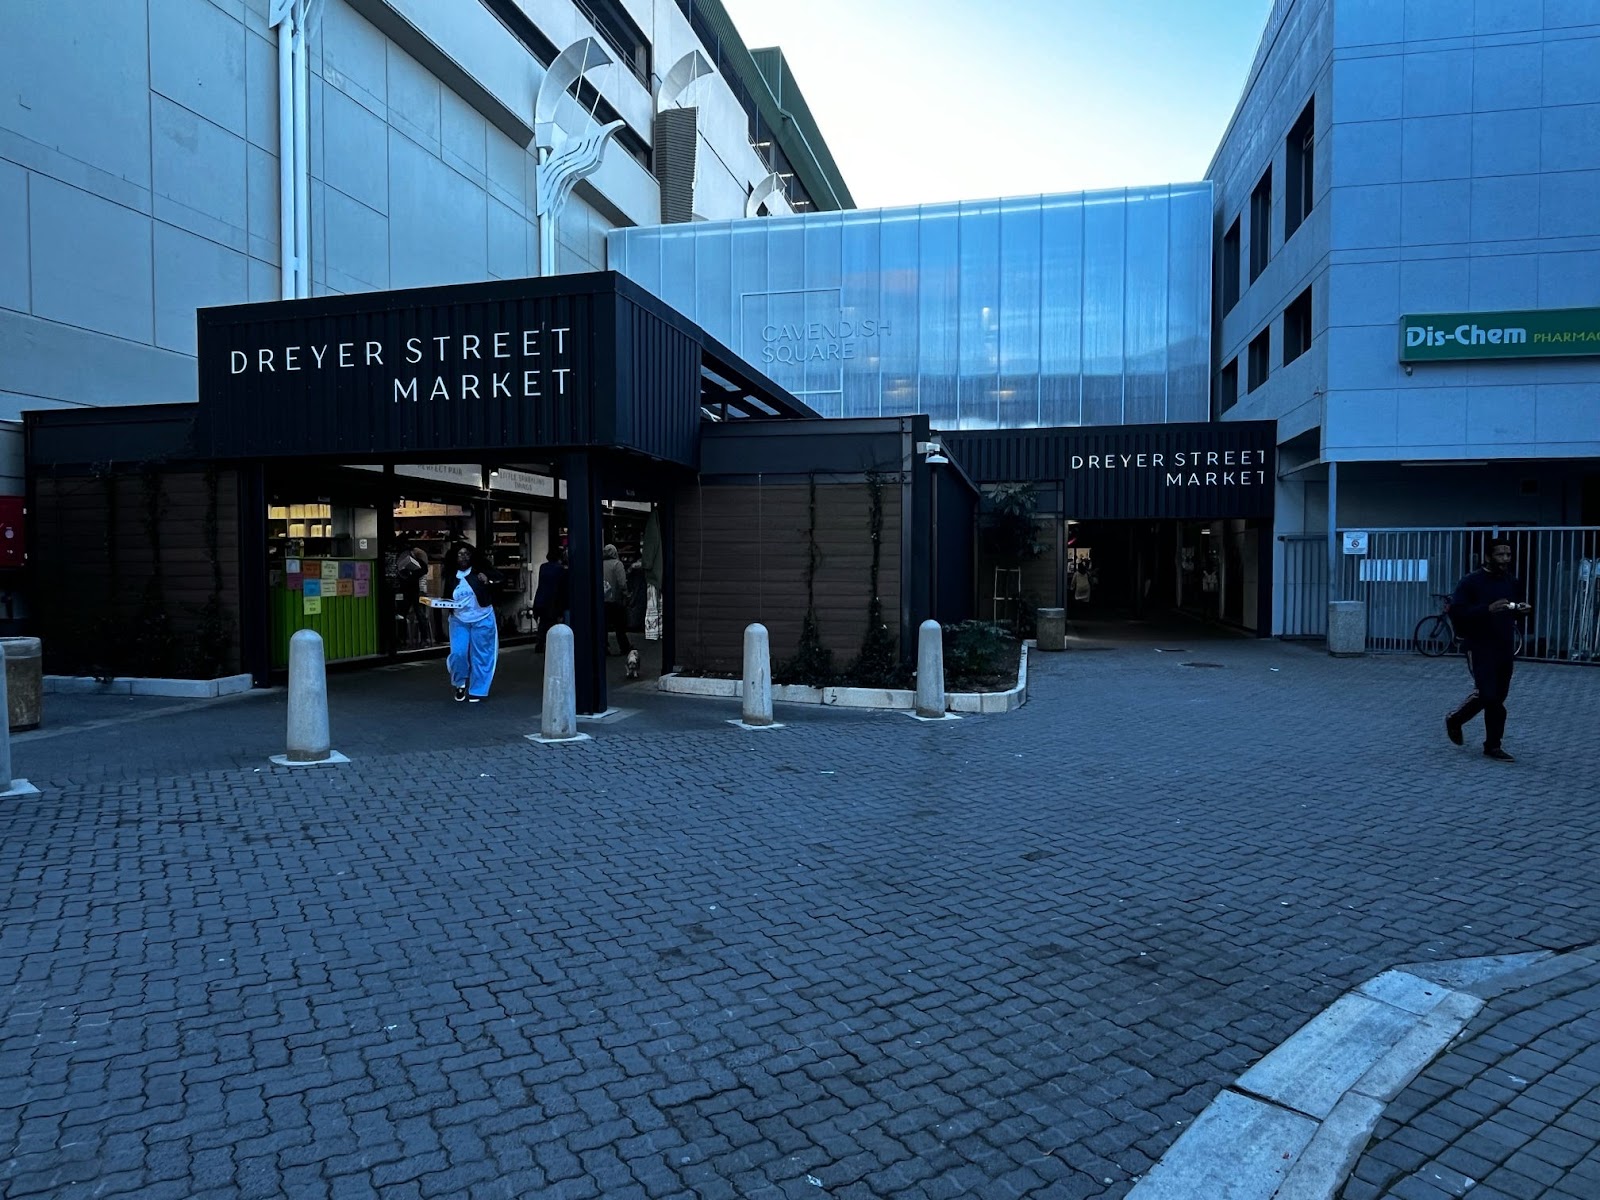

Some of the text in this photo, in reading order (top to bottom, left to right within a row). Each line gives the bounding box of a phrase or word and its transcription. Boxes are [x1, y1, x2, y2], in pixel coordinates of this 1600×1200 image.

[762, 320, 892, 343] CAVENDISH
[1406, 324, 1527, 347] Dis-Chem
[231, 328, 570, 374] DREYER STREET
[762, 342, 855, 366] SQUARE
[394, 368, 571, 403] MARKET
[1071, 450, 1265, 470] DREYER STREET
[1166, 470, 1265, 487] MARKET
